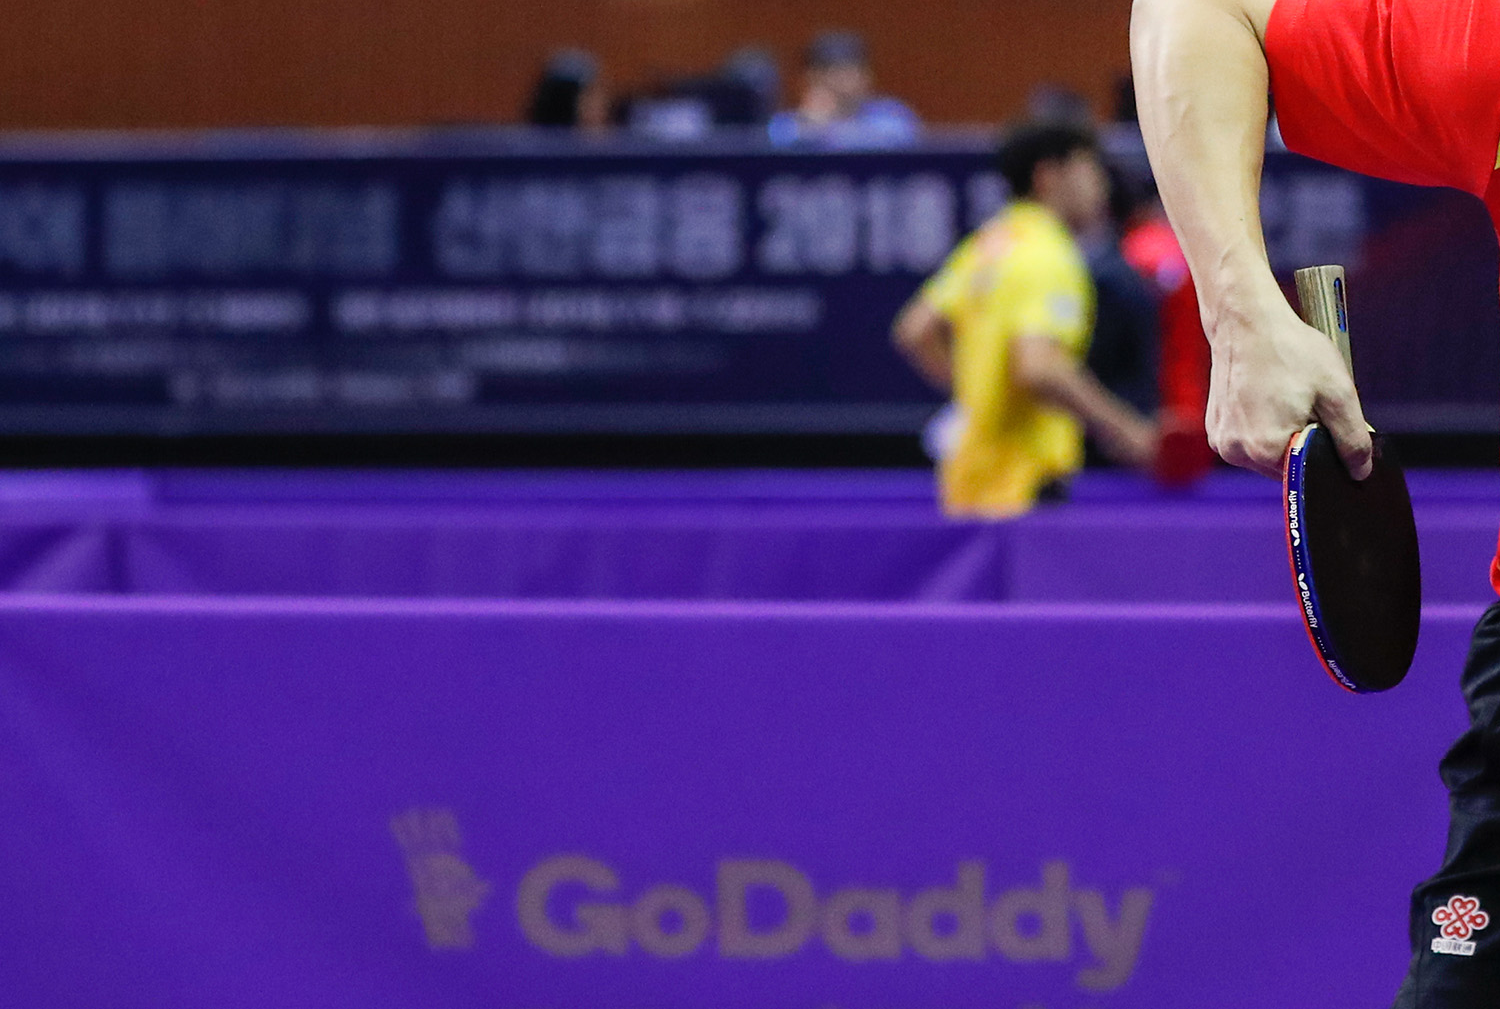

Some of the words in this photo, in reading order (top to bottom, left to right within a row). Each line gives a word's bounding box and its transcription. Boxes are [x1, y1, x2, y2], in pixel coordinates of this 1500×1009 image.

[1288, 490, 1299, 529] Butterfly
[1301, 590, 1318, 628] Butterfly
[515, 852, 1154, 992] GoDaddy
